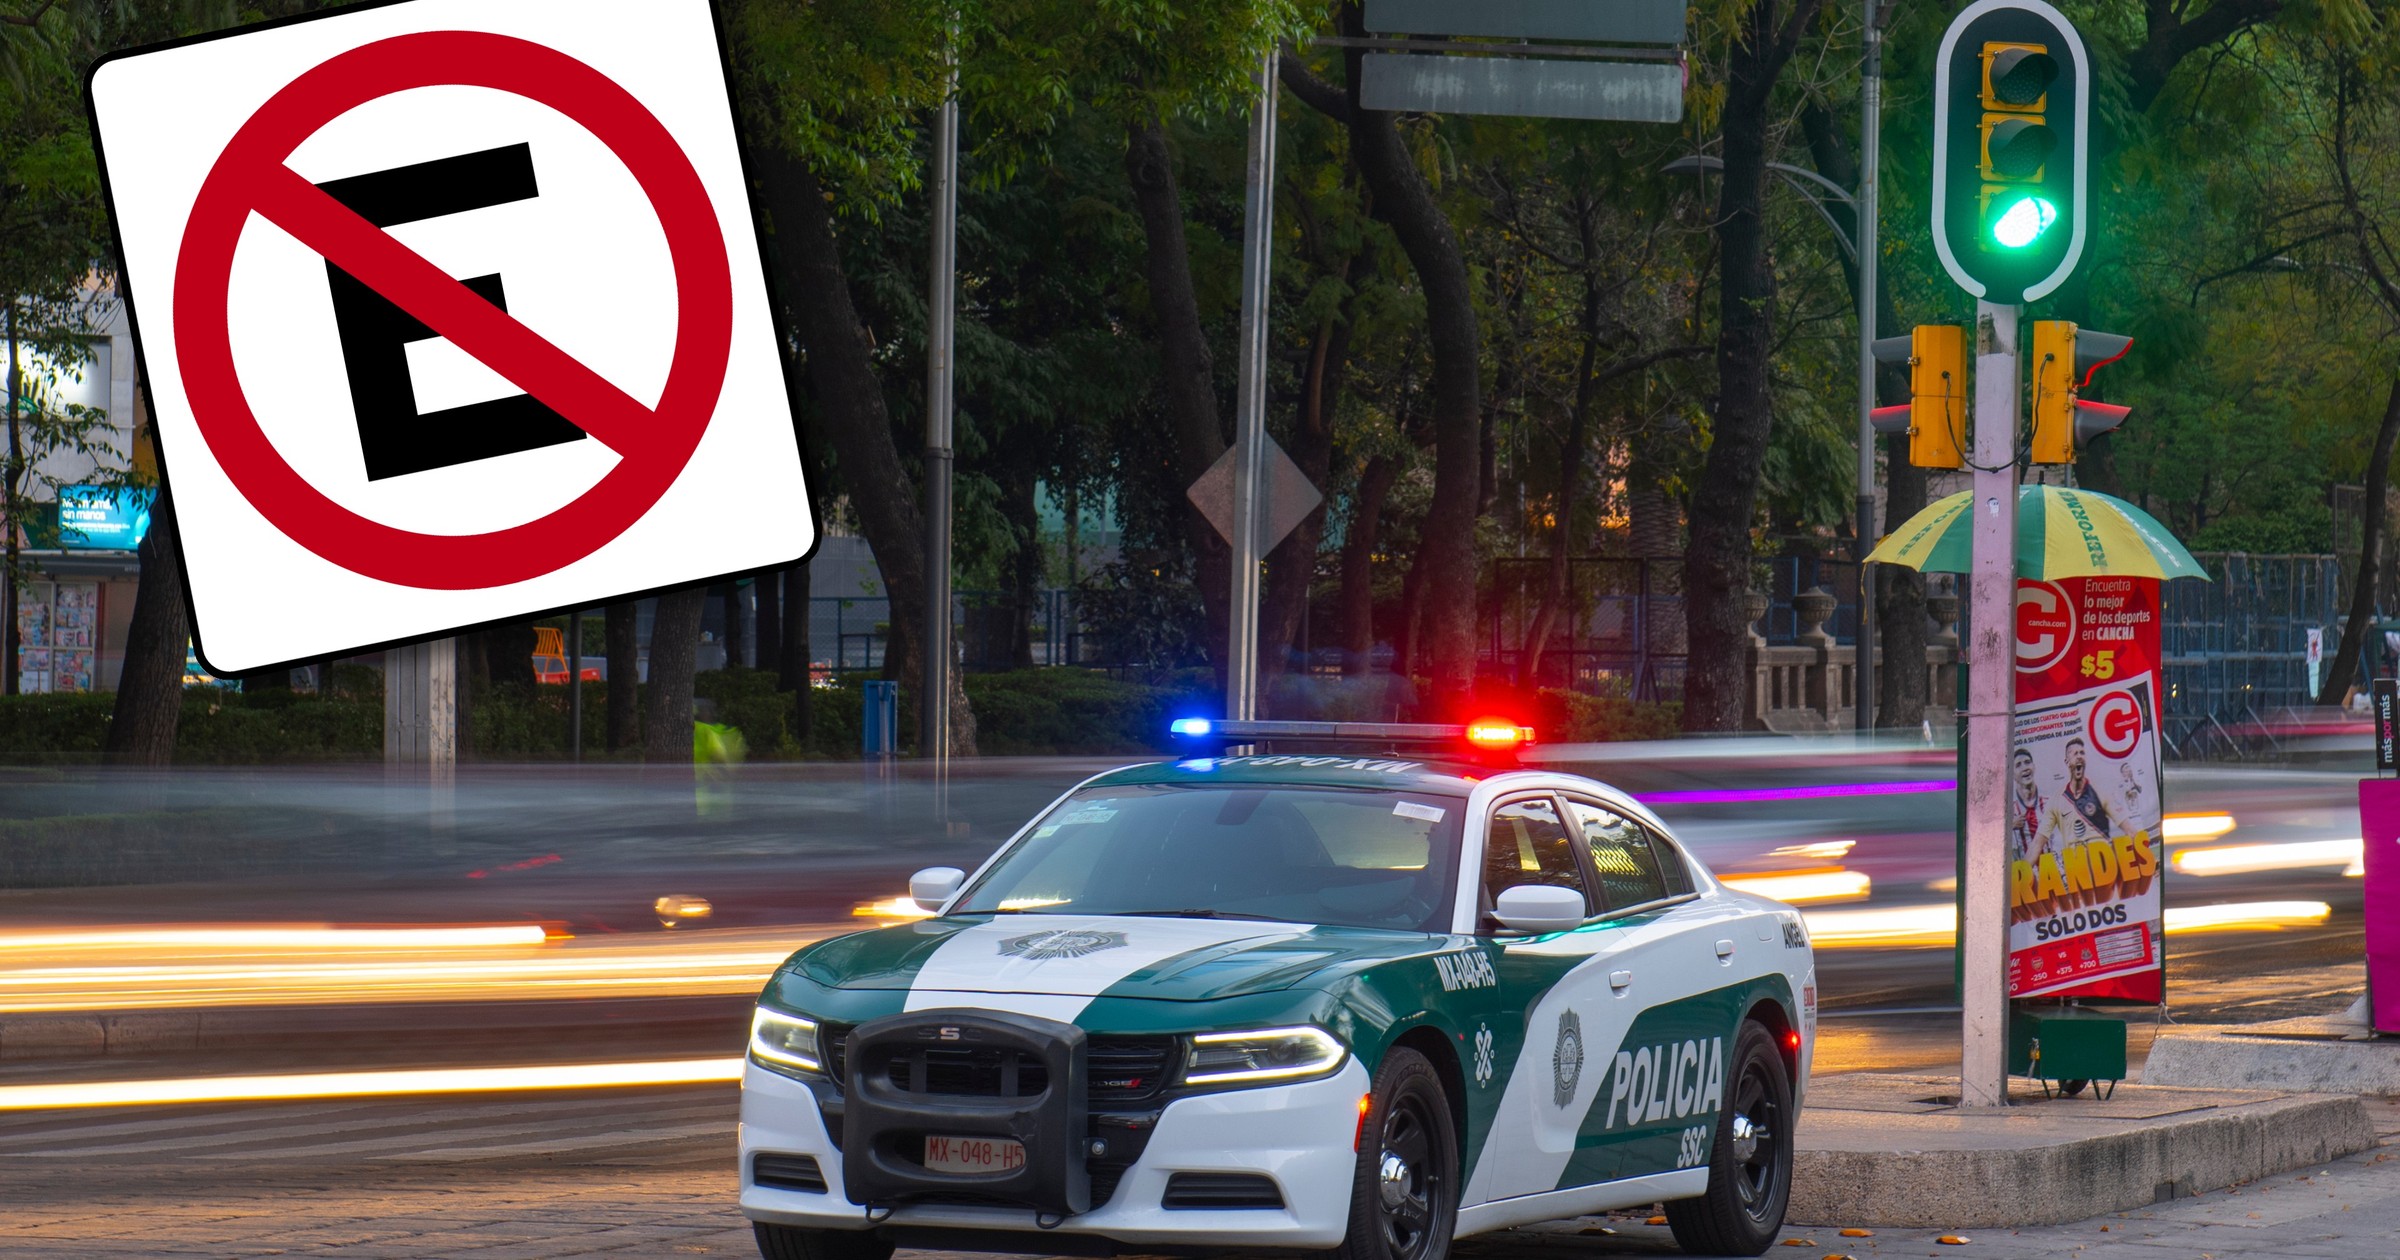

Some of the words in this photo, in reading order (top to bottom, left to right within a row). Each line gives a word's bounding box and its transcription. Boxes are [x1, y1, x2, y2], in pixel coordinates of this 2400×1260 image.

[2085, 579, 2131, 592] Encuentra
[2083, 611, 2096, 624] de
[2098, 612, 2113, 624] los
[2114, 610, 2150, 625] deportes
[2084, 595, 2094, 608] lo
[2096, 596, 2125, 610] mejor
[2028, 619, 2067, 628] cancha.com
[2082, 629, 2095, 641] en
[2096, 626, 2135, 641] CANCHA
[2080, 650, 2115, 679] $5
[2379, 694, 2394, 763] máspormás
[2011, 829, 2157, 910] RANDES
[2036, 912, 2087, 941] SÓLO
[2088, 904, 2127, 929] DOS
[1433, 951, 1496, 992] MX-048-H5
[2079, 960, 2097, 969] +700
[1605, 1036, 1722, 1130] POLICIA
[928, 1138, 1025, 1169] MX-048-H5
[1677, 1125, 1707, 1168] SSC
